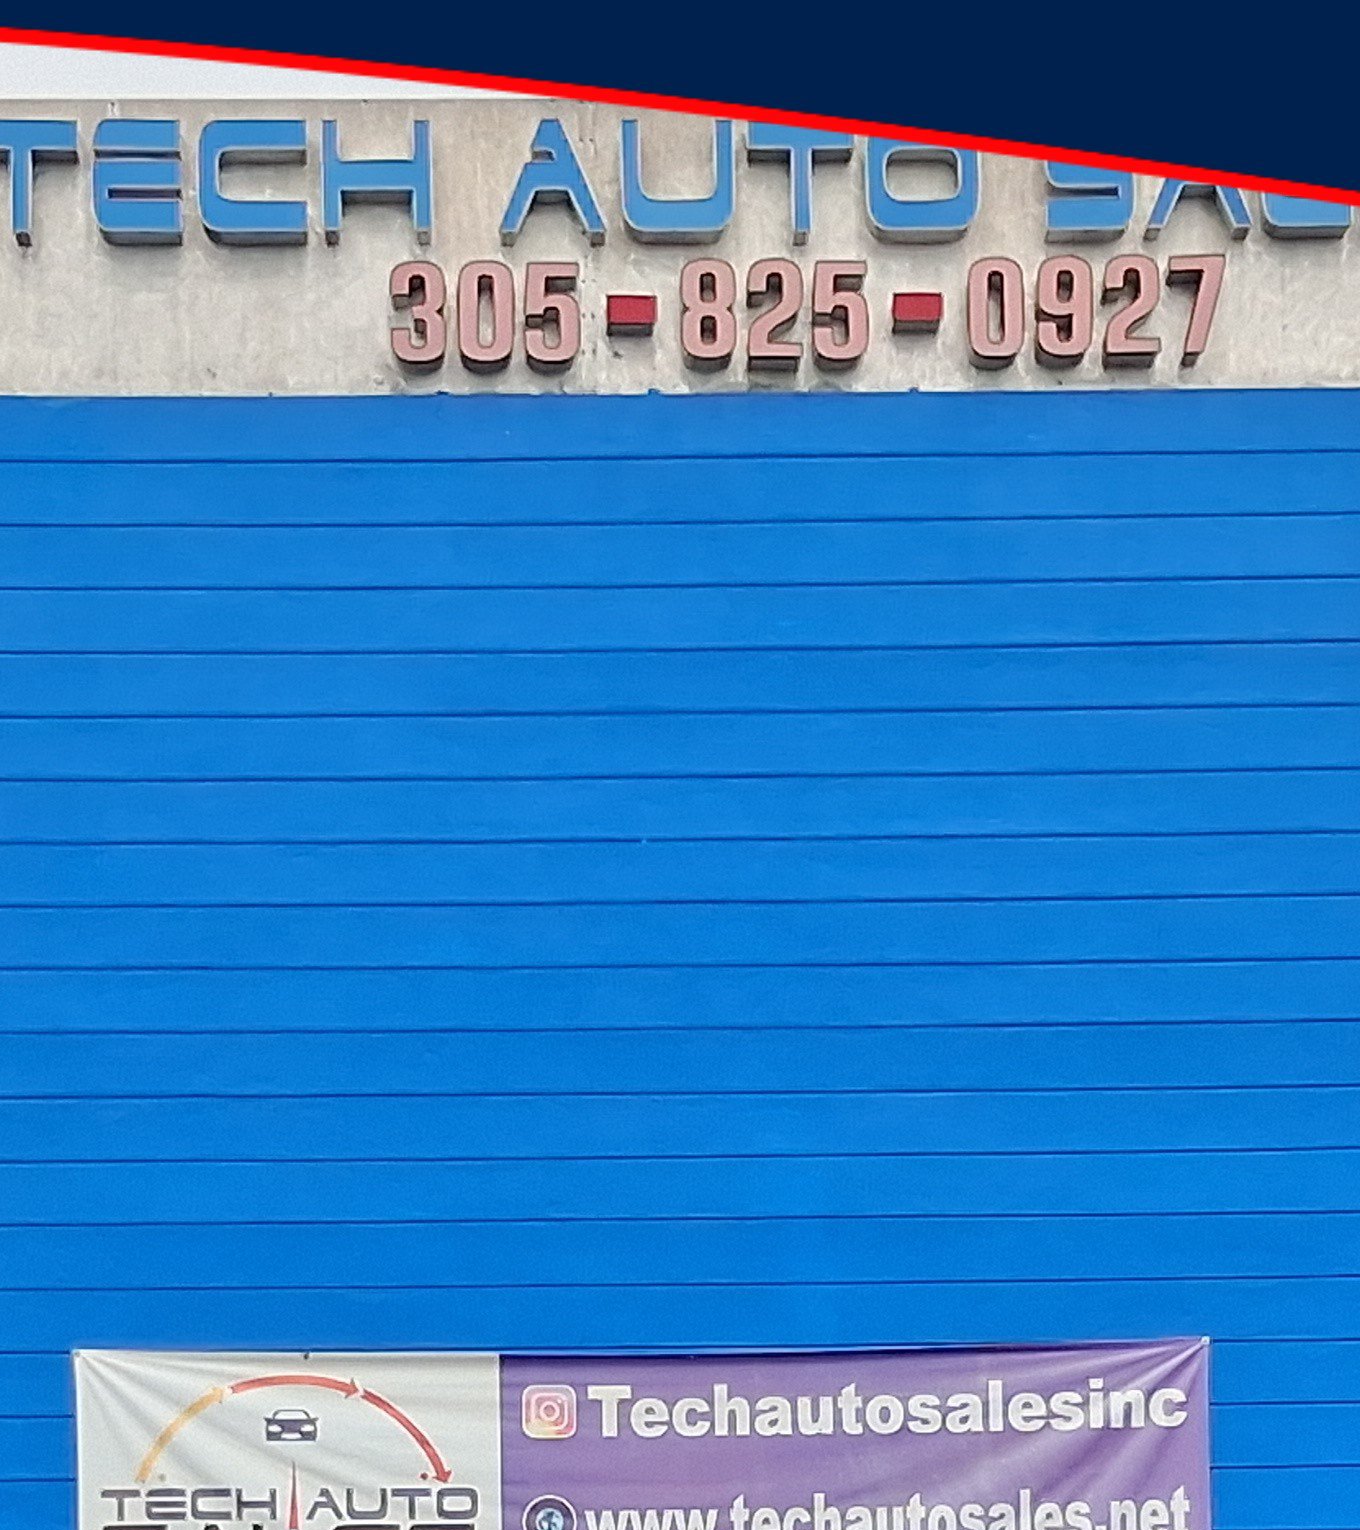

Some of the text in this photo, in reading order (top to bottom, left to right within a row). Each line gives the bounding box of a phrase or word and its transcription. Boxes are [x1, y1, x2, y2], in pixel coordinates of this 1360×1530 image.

[500, 117, 982, 244] AUTO
[389, 254, 1227, 372] 305-825-0927
[586, 1377, 1189, 1438] Techautosalesinc
[100, 1487, 479, 1521] TECH AUTO
